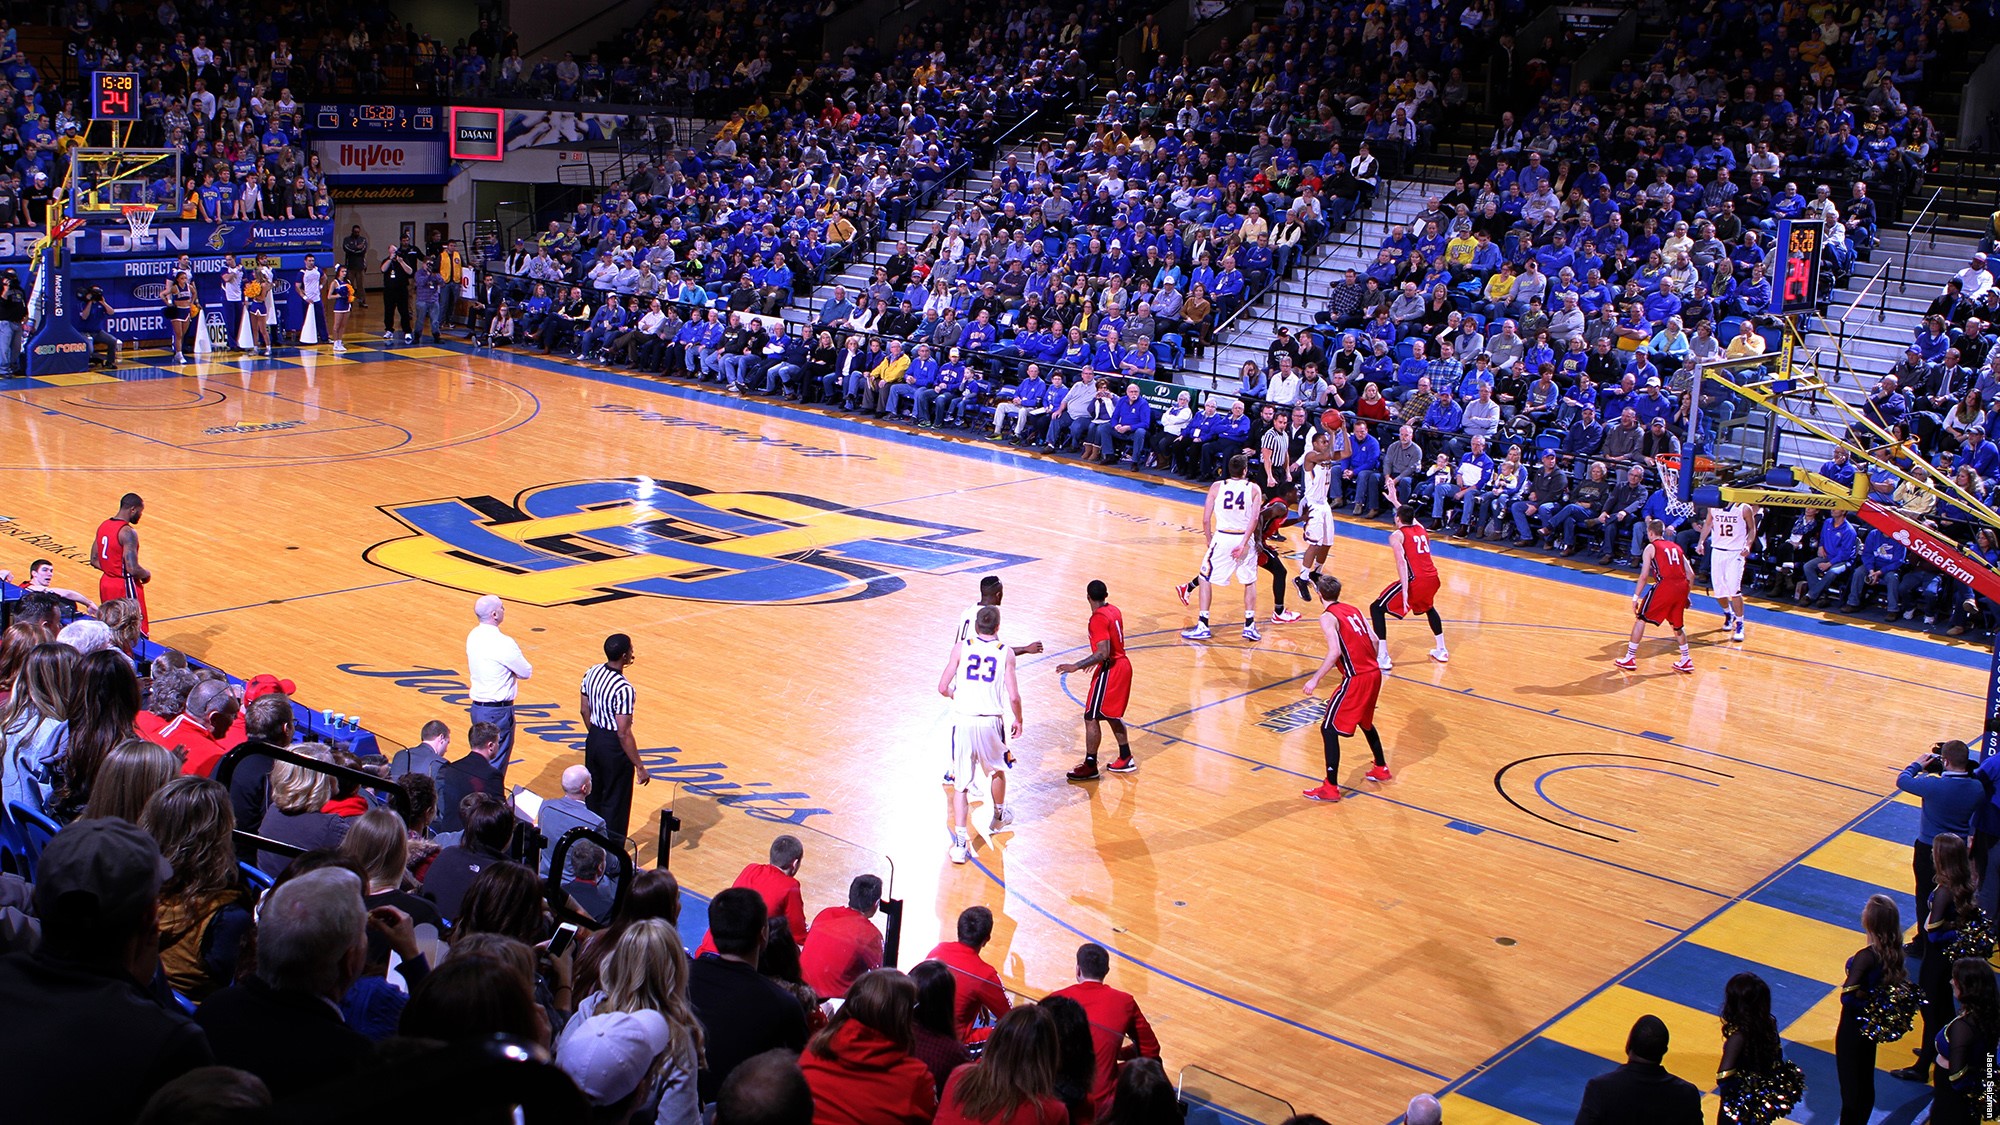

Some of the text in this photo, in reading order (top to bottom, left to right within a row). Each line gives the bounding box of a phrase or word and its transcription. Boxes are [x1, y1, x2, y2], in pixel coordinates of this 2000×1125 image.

[102, 76, 132, 91] 15:28
[102, 91, 129, 114] 24
[319, 105, 338, 113] JACKS
[365, 105, 394, 119] 15:28
[417, 106, 432, 115] GUEST
[330, 115, 338, 126] 4
[422, 116, 433, 128] 14
[460, 129, 493, 140] DASANI
[101, 227, 190, 253] DEN
[253, 228, 287, 238] MILLS
[125, 261, 172, 276] PROTECT
[1783, 257, 1811, 301] 24
[107, 316, 164, 333] PIONEER
[1223, 490, 1245, 511] 24
[1755, 494, 1838, 508] Jackrabbits
[1714, 514, 1738, 524] STATE
[1719, 524, 1733, 537] 12
[101, 535, 109, 560] 2
[1412, 535, 1431, 554] 23
[1664, 546, 1681, 566] 14
[966, 653, 998, 683] 23
